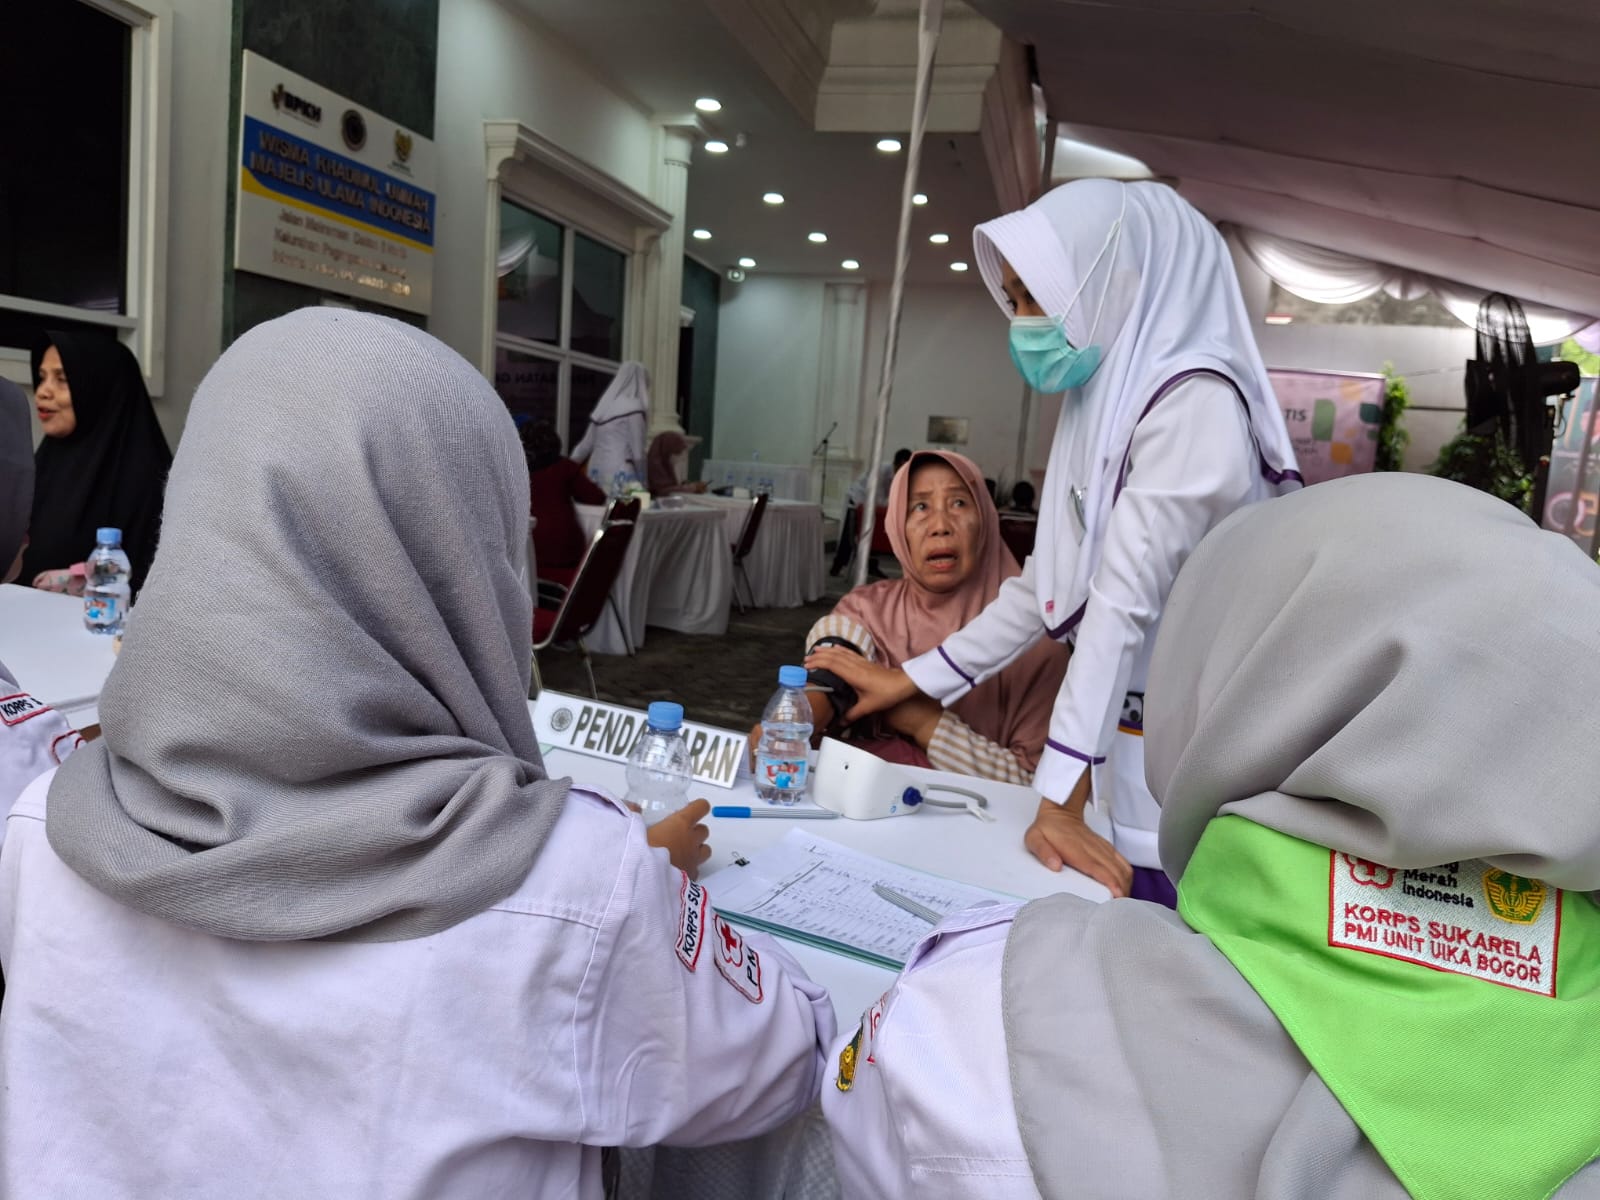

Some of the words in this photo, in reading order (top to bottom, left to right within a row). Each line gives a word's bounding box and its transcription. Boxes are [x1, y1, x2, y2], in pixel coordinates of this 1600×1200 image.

[260, 130, 309, 165] WISMA
[251, 151, 314, 191] MAJELIS
[319, 177, 365, 210] ULAMA
[371, 197, 431, 234] INDONESIA
[1284, 408, 1306, 422] TIS
[1, 699, 34, 717] KORPS
[570, 705, 741, 783] PENDAARAN
[1402, 881, 1474, 908] Indonesia
[1403, 869, 1458, 888] Merah
[682, 907, 698, 958] KORPS
[1344, 902, 1421, 933] KORPS
[1428, 921, 1543, 965] SUKARELA
[1344, 922, 1378, 943] PMI
[1384, 929, 1425, 953] UNIT
[1431, 940, 1472, 967] UIKA
[1477, 953, 1541, 984] BOGOR
